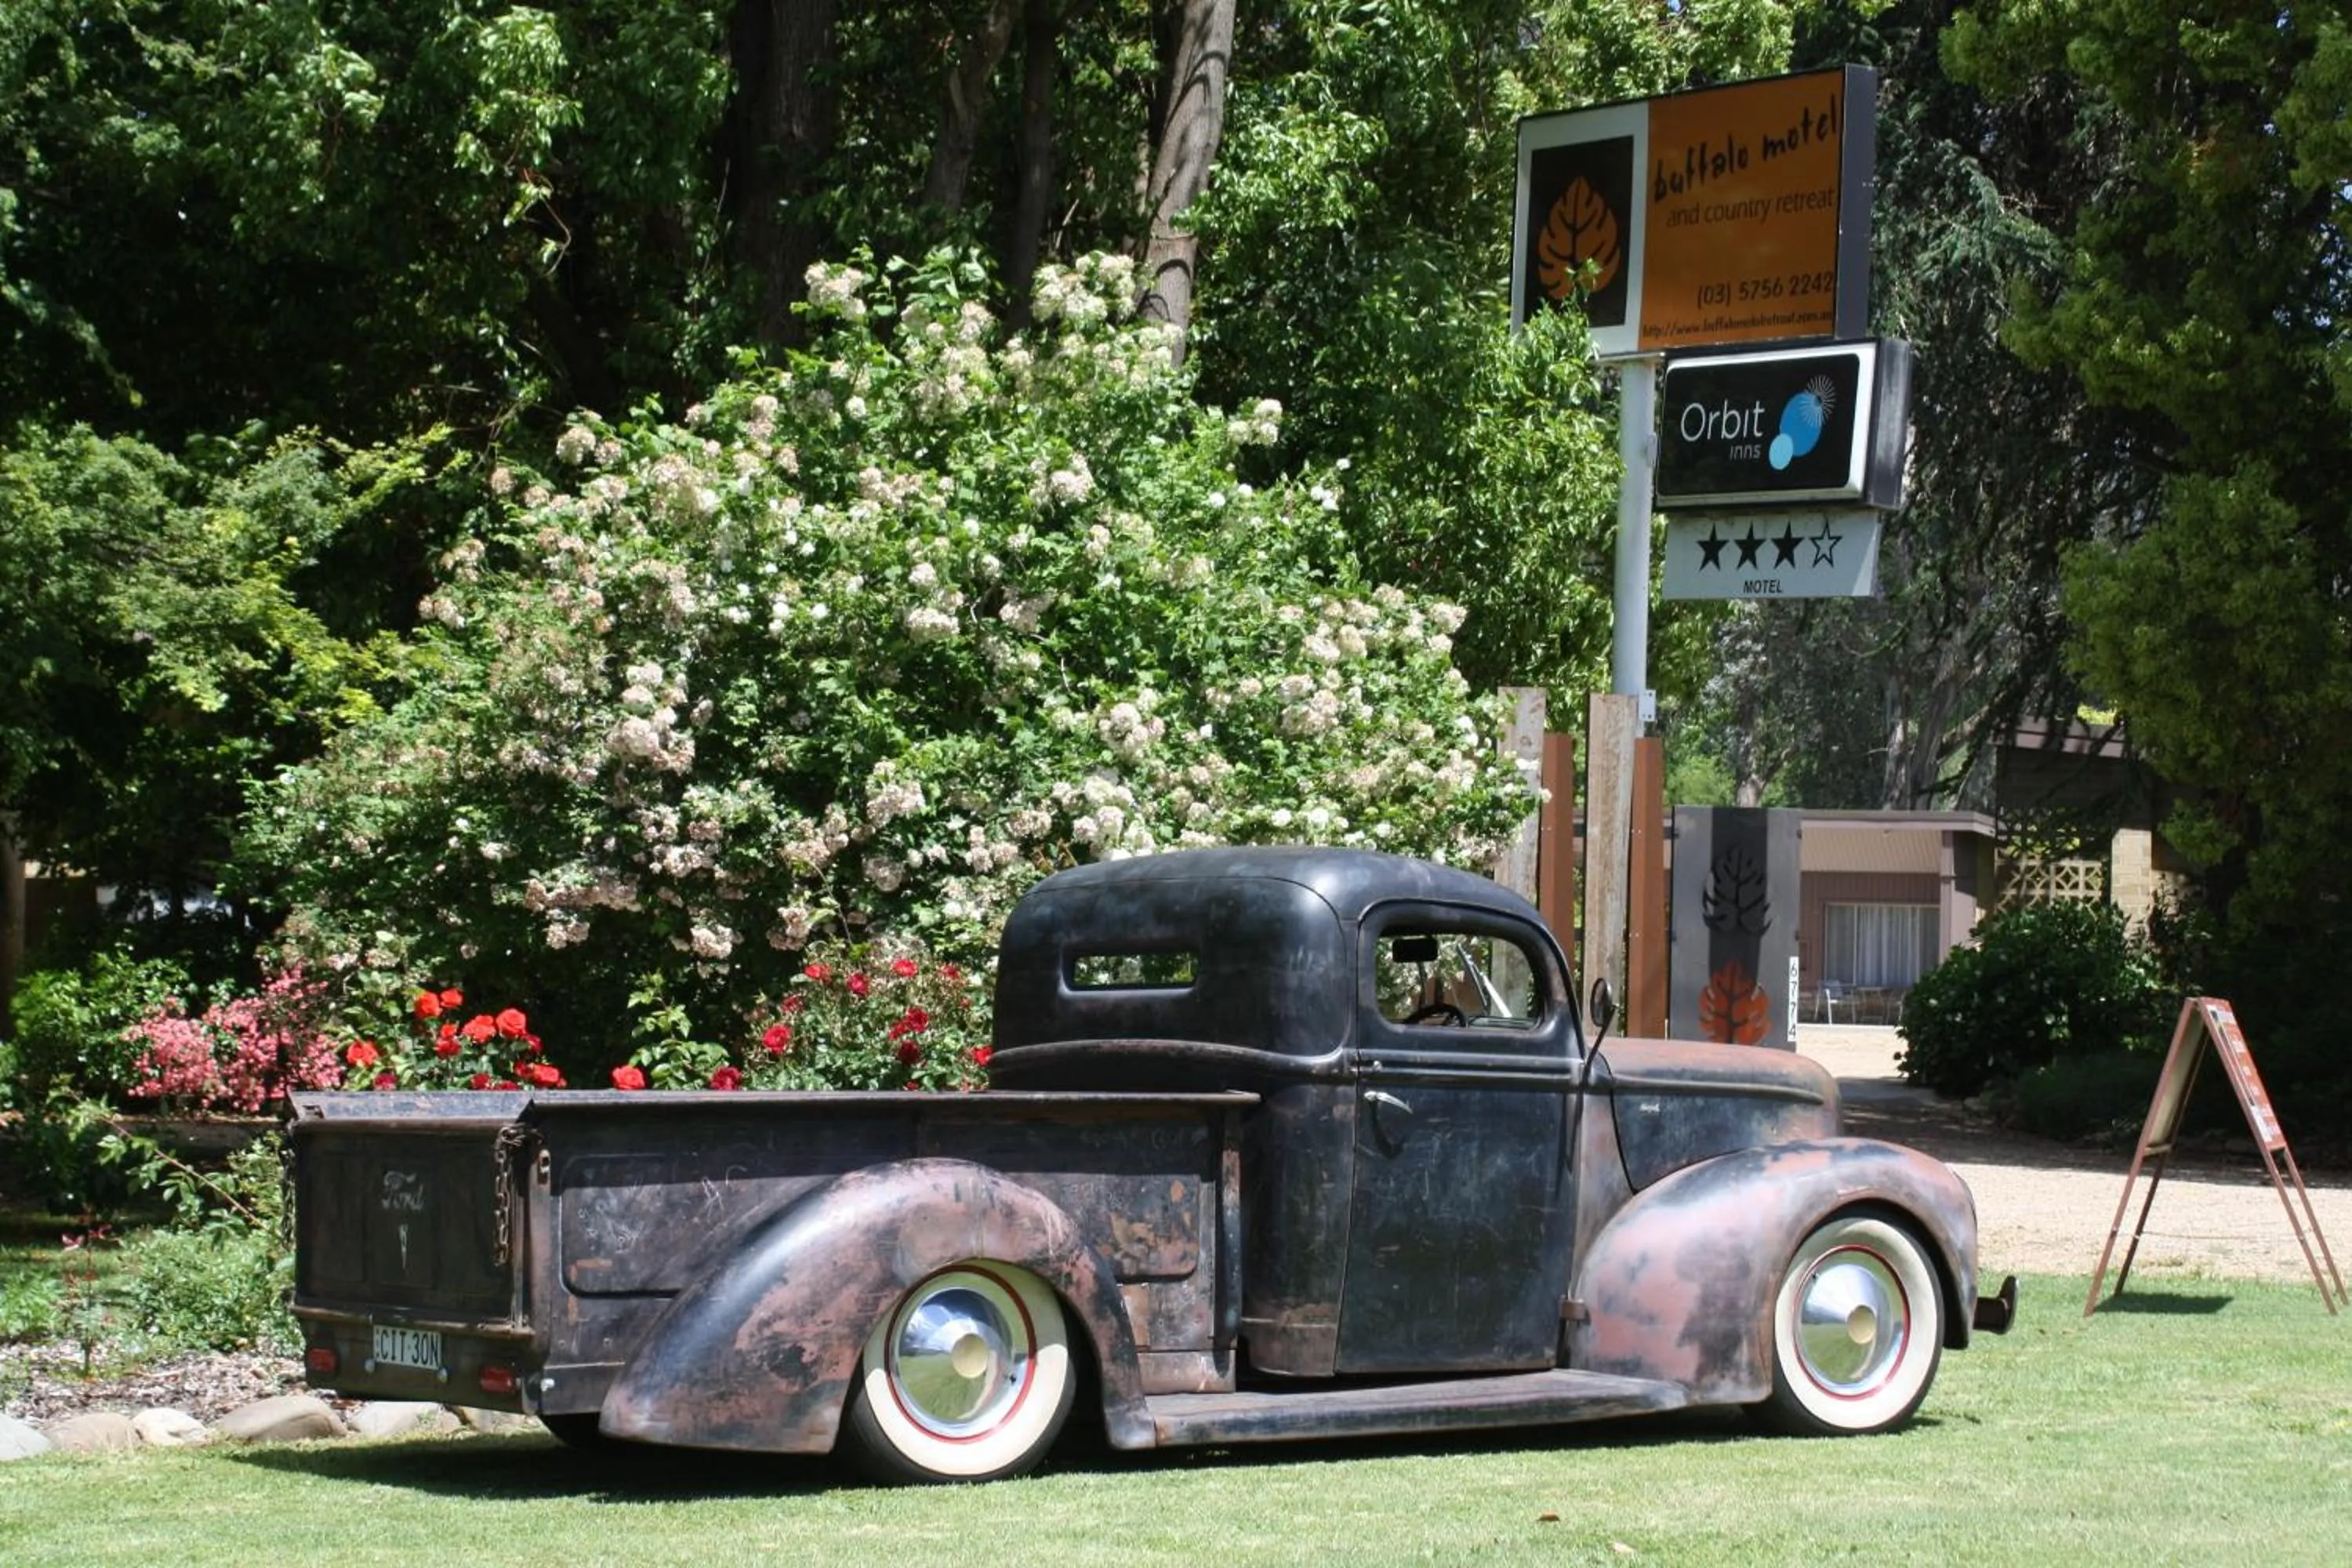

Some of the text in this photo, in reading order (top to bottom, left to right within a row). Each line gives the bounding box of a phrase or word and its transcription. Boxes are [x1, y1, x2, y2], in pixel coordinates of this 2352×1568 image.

[1654, 93, 1837, 203] buffalo motel
[1666, 188, 1835, 228] and country retreat
[1697, 271, 1835, 310] (03) 5756 2242
[1680, 399, 1766, 442] Orbit
[1729, 443, 1762, 461] inns
[1742, 579, 1783, 594] MOTEL
[380, 1170, 424, 1211] Ford
